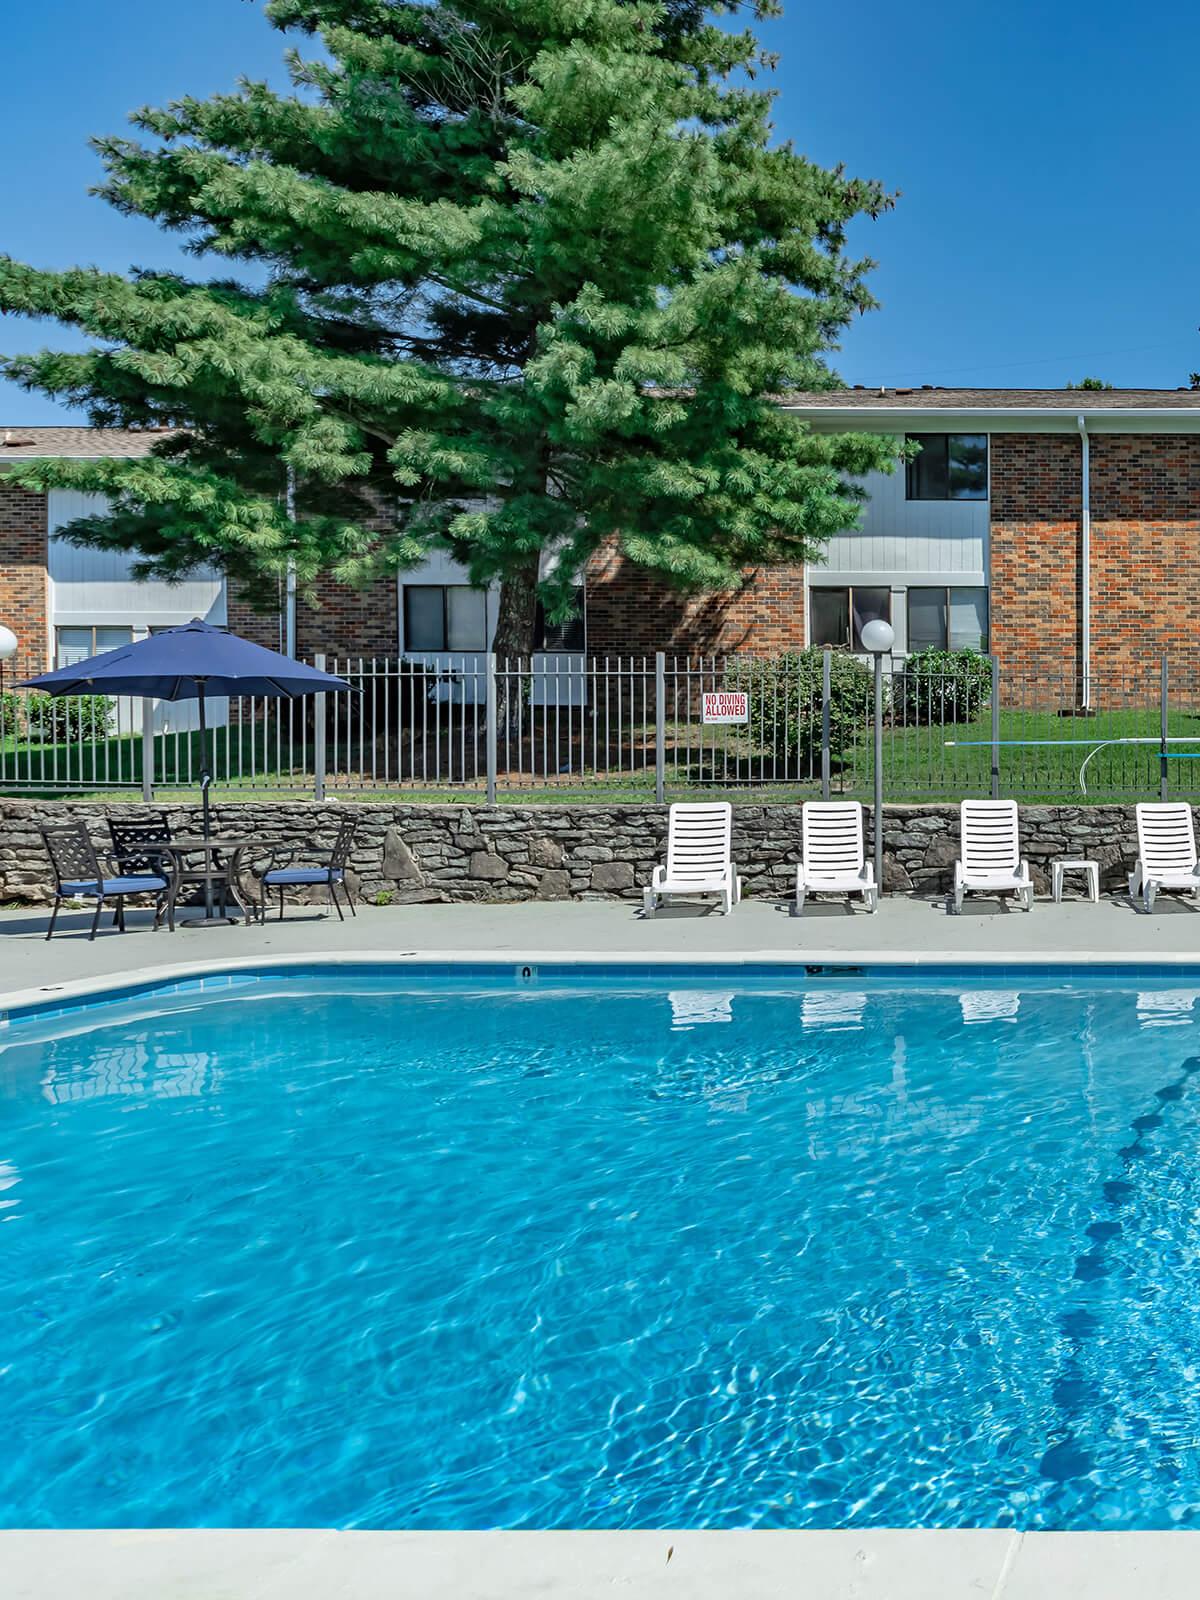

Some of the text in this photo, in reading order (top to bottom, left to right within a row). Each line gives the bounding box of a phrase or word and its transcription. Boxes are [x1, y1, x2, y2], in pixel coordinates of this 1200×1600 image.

[705, 694, 745, 704] NO DIVING
[705, 705, 746, 716] ALLOWED
